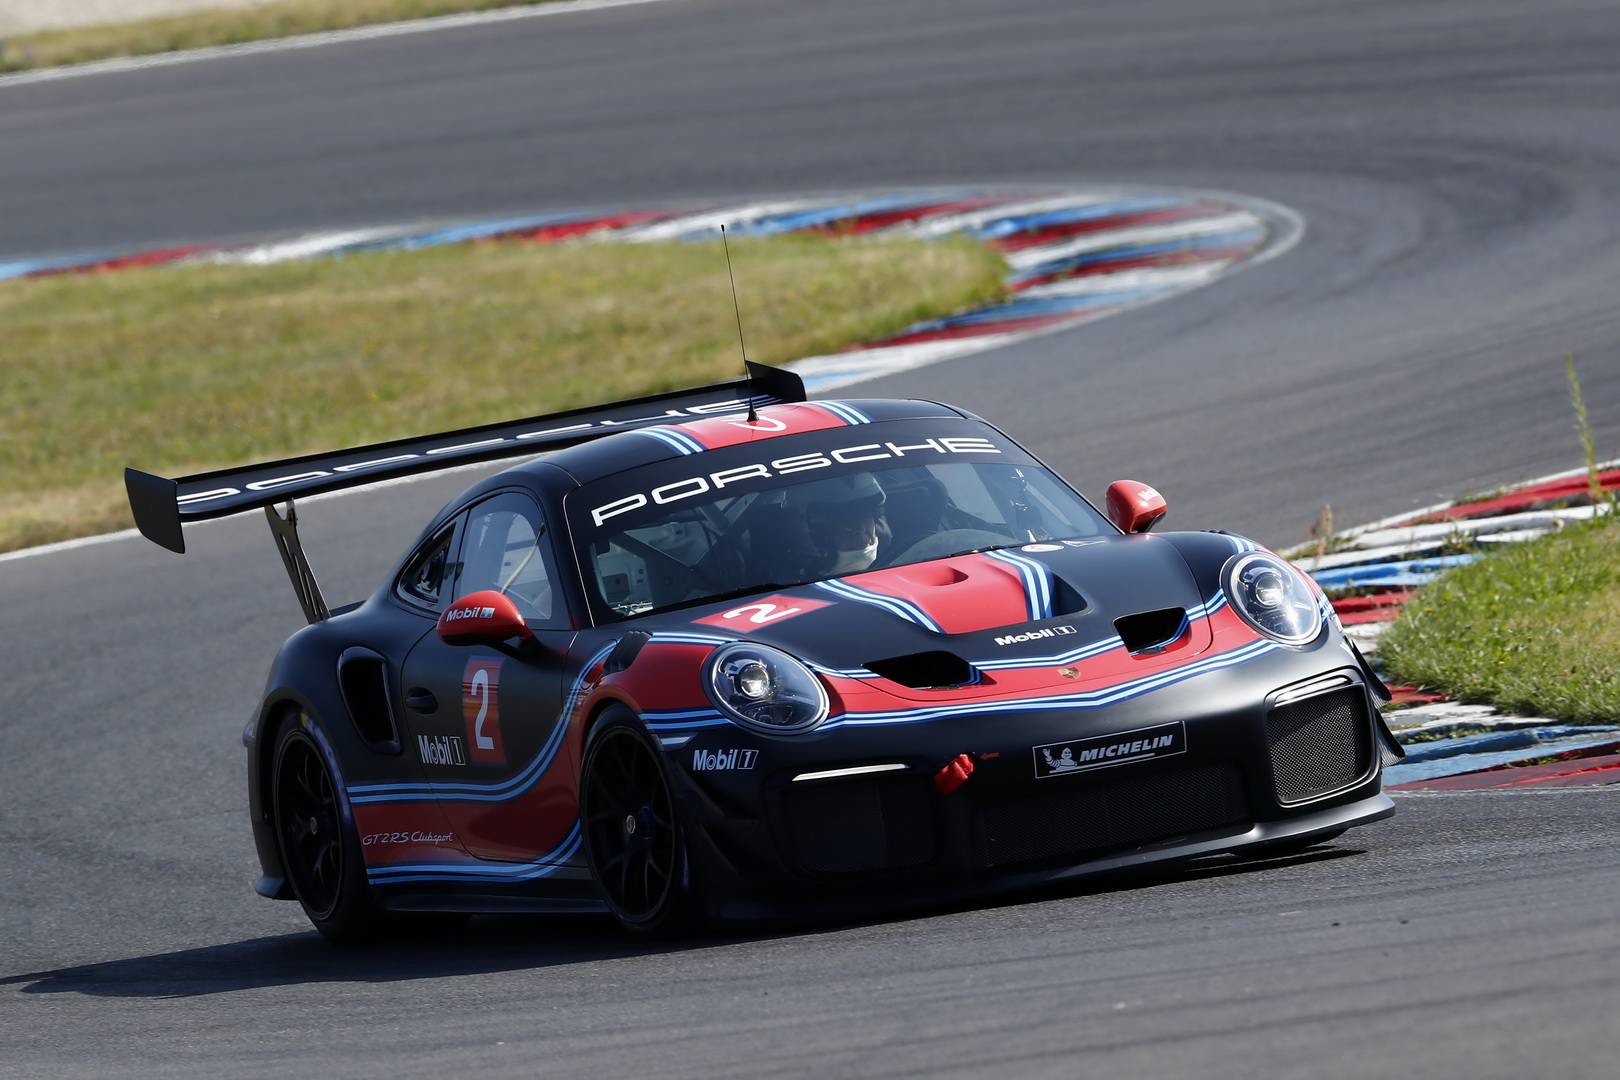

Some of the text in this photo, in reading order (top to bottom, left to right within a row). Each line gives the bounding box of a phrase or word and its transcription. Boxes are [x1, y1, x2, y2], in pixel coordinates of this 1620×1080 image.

[591, 437, 1002, 527] PORSCHE
[446, 607, 480, 622] Mobil
[722, 603, 802, 624] 2
[994, 628, 1055, 646] Mobil
[471, 669, 495, 750] 2
[418, 735, 453, 765] Mobil
[1079, 734, 1173, 762] MICHELIN
[692, 749, 738, 771] Mobil
[411, 831, 453, 845] Clubsport
